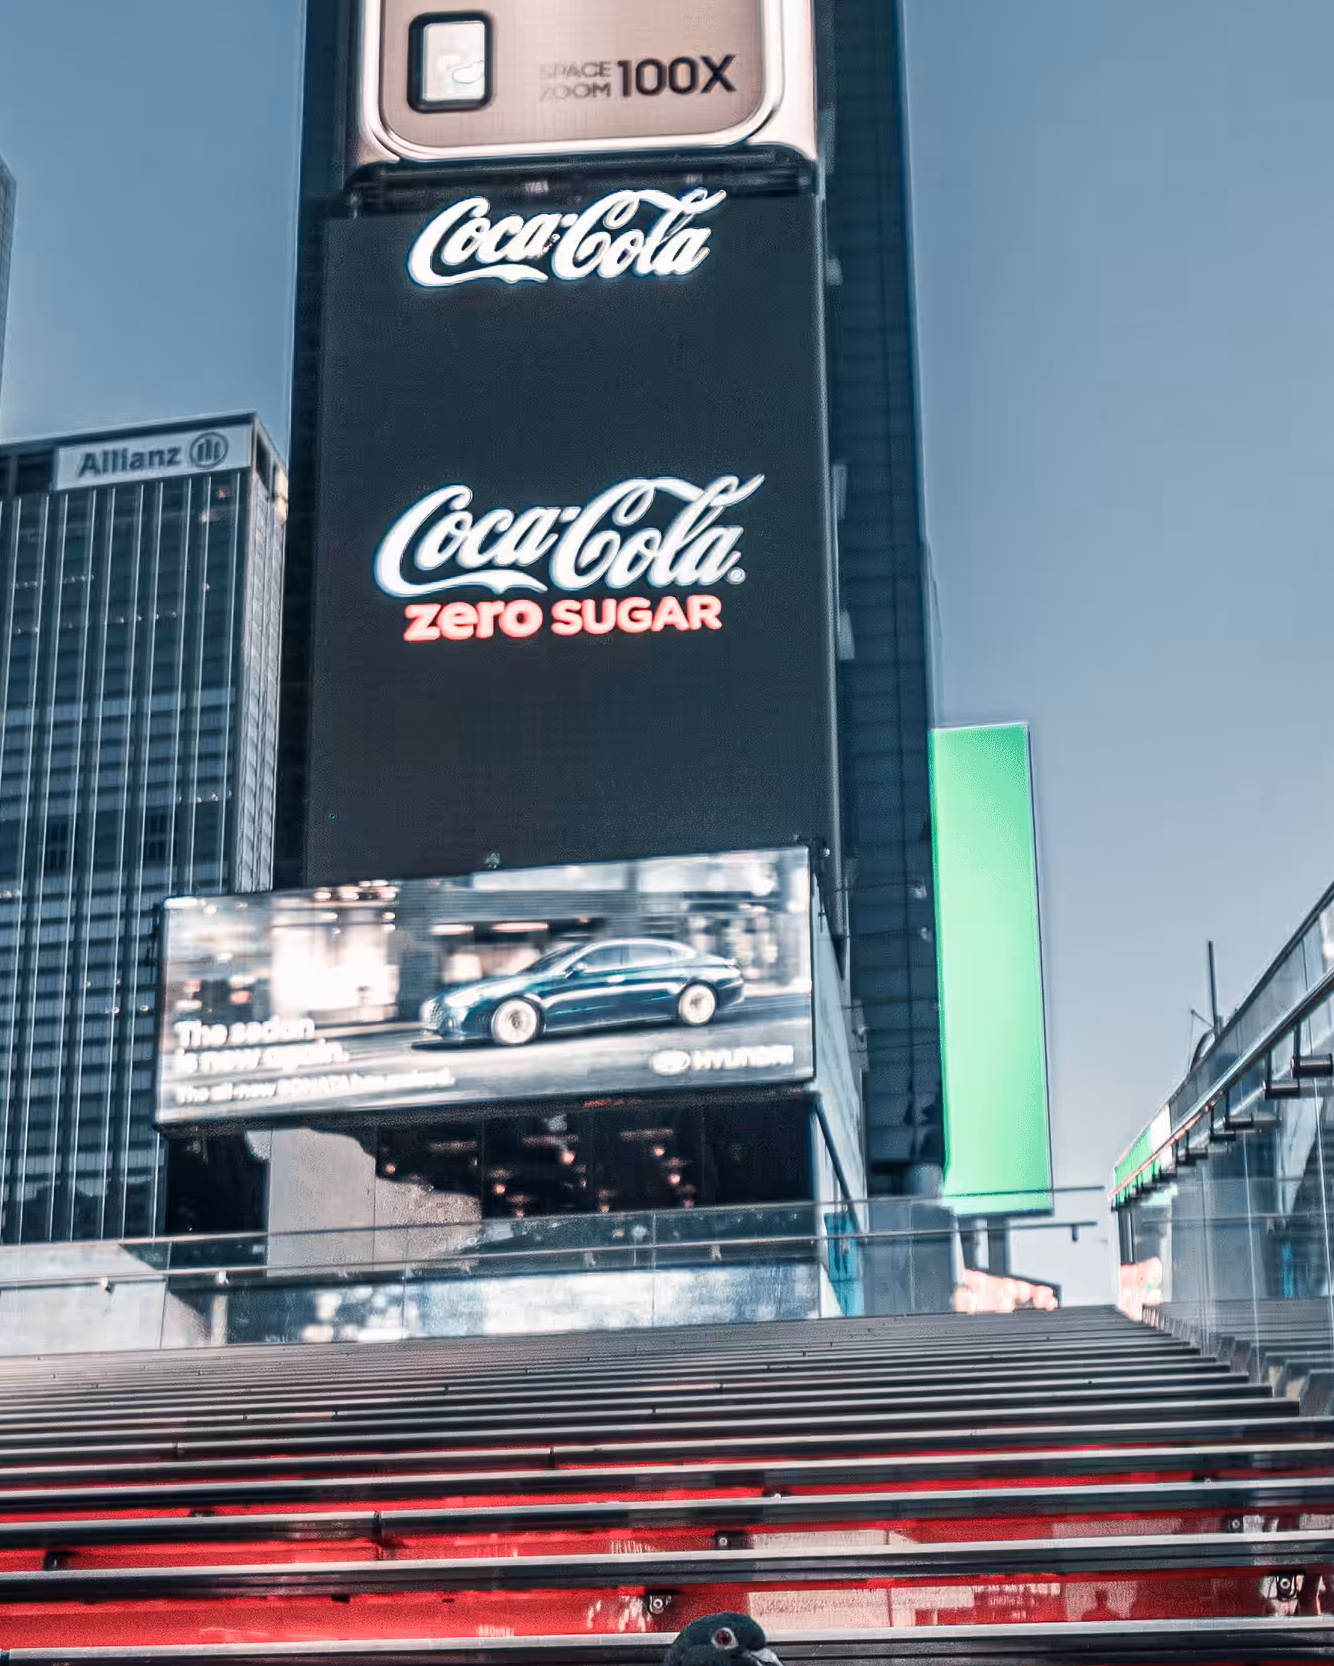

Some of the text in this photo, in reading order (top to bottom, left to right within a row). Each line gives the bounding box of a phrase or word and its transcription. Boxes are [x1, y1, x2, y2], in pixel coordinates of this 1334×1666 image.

[539, 61, 612, 80] SPACE
[617, 53, 737, 98] 100X
[539, 81, 612, 101] ZOOM
[407, 186, 727, 288] Coca-Cola
[78, 445, 182, 479] Allianz
[372, 473, 766, 599] Coca-Cola
[403, 595, 723, 642] zero SUGAR
[175, 1015, 316, 1046] The sedan
[199, 1048, 261, 1071] new
[690, 1043, 795, 1070] HYUNDAI
